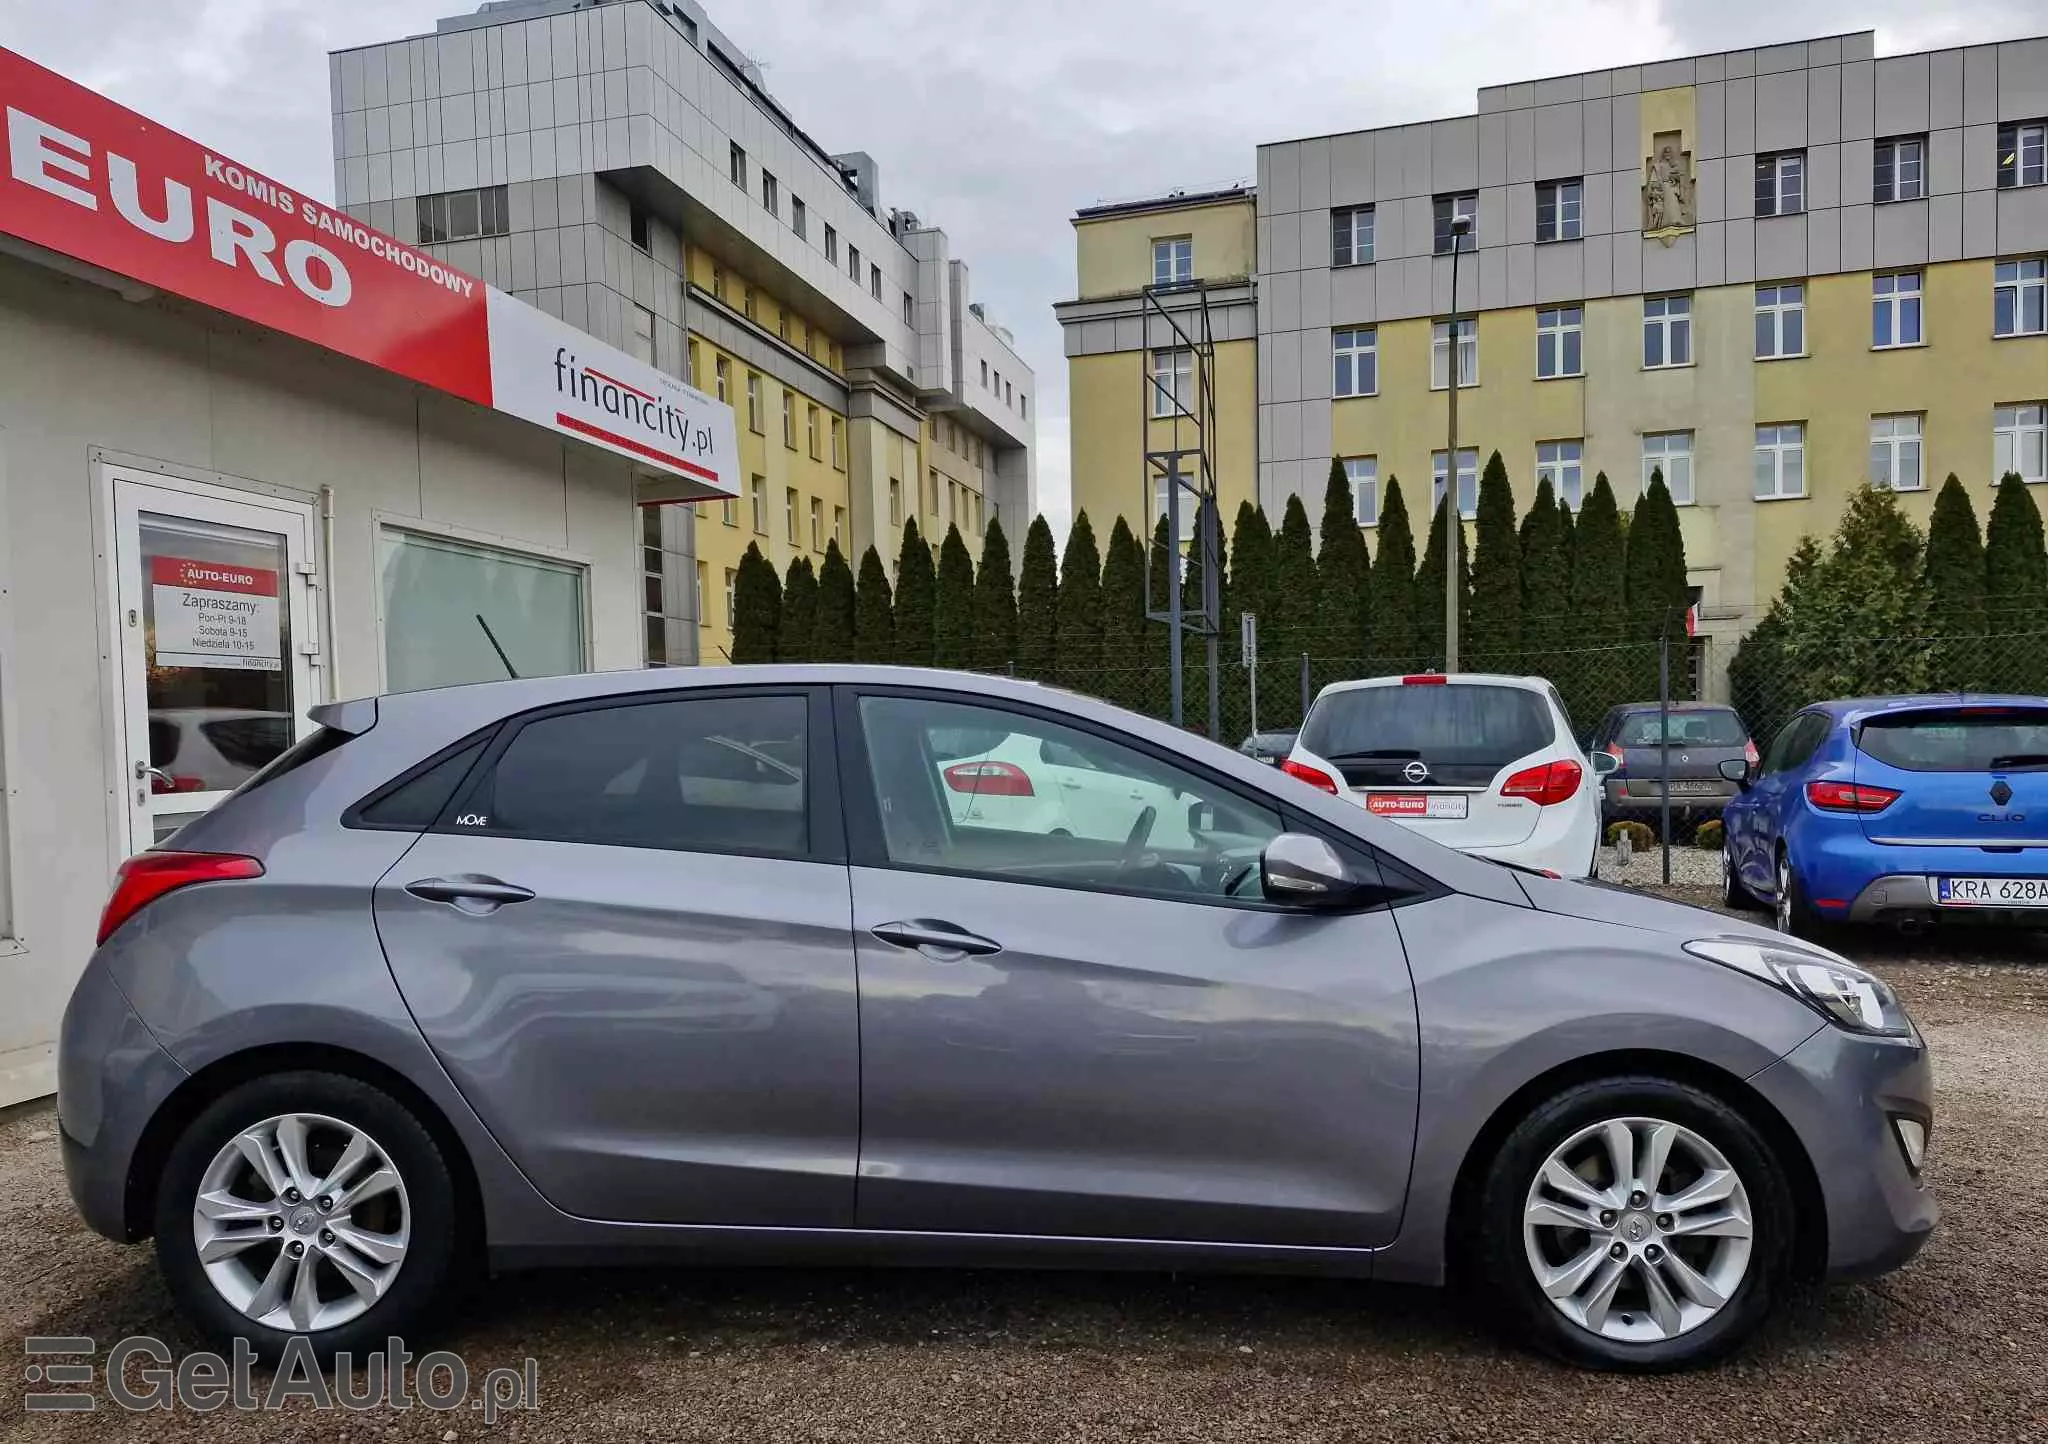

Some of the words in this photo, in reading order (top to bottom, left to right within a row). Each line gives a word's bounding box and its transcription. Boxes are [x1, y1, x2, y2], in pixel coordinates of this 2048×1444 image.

[7, 105, 353, 307] EURO
[204, 154, 294, 215] KOMIS
[303, 202, 473, 299] SAMOCHODOWY
[554, 347, 714, 457] financity.pl
[187, 568, 254, 585] AUTO-EURO
[228, 615, 247, 626] 9-18
[199, 625, 228, 637] Sobota
[229, 627, 248, 638] 9-15
[192, 637, 230, 650] Niedziela
[232, 639, 256, 651] 10-15
[1371, 800, 1425, 810] AUTO-EURO
[456, 813, 488, 826] MOVE
[1951, 880, 1992, 899] KRA
[1999, 881, 2048, 900] 628A
